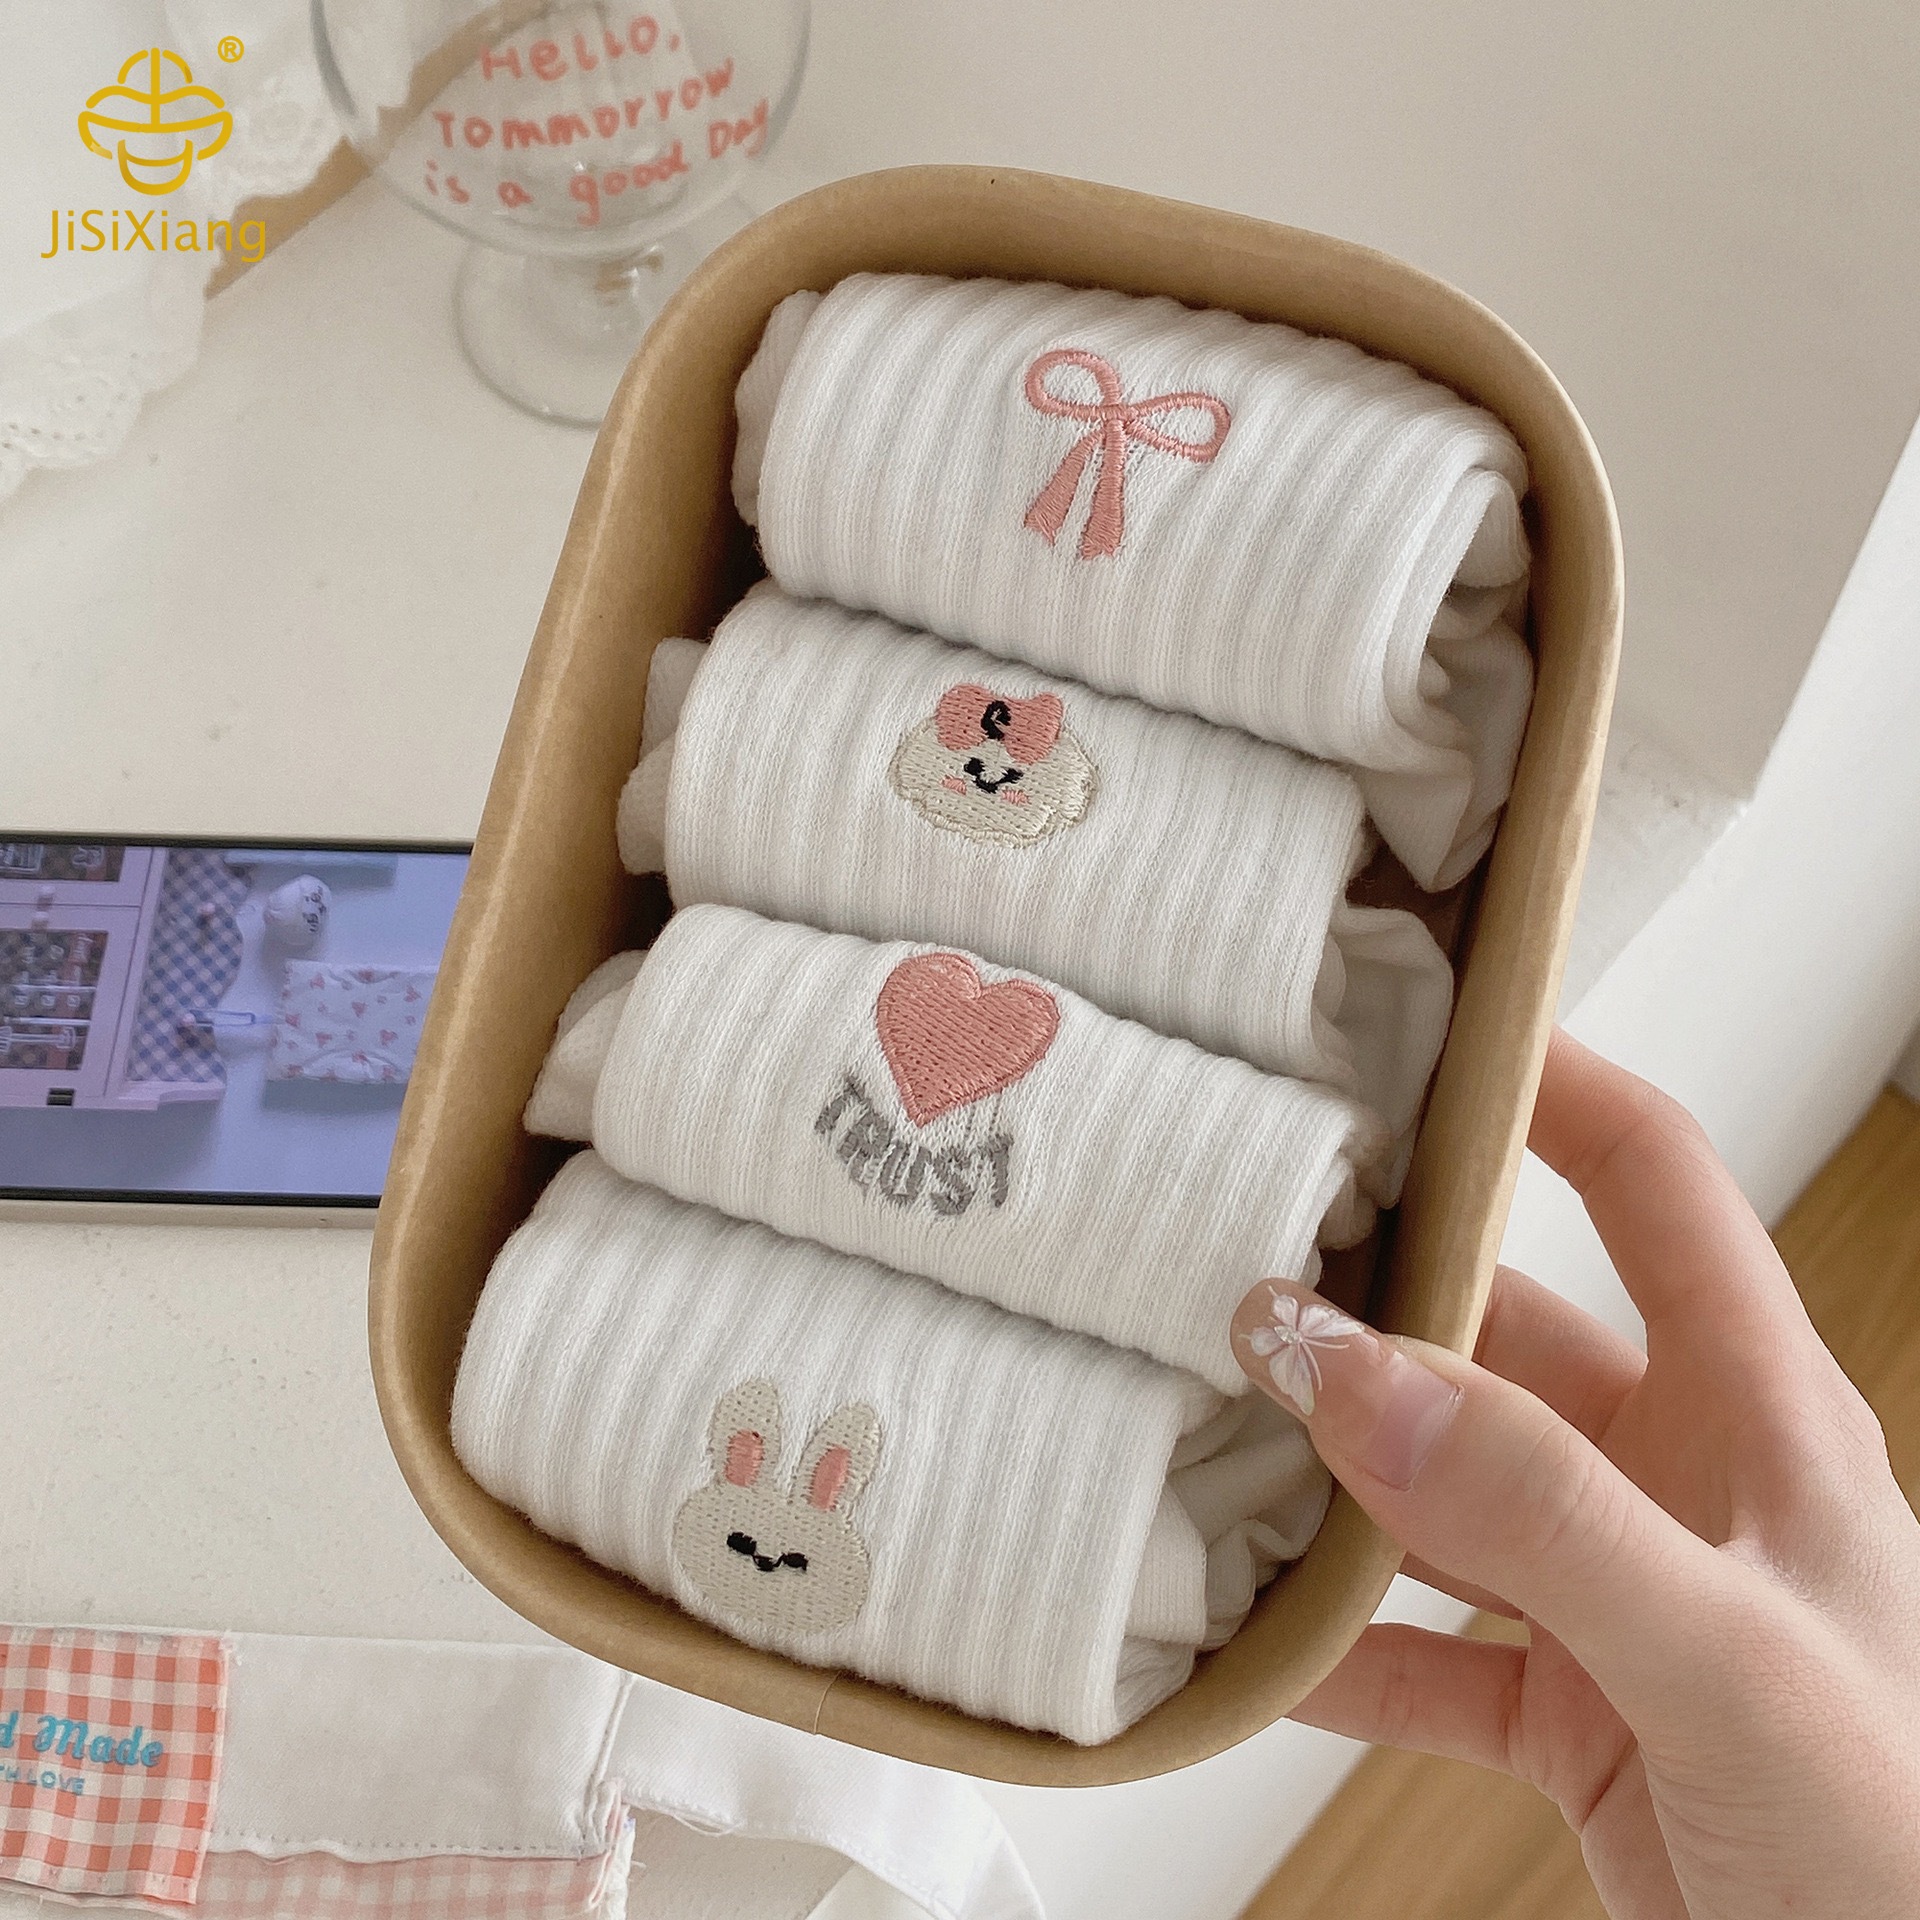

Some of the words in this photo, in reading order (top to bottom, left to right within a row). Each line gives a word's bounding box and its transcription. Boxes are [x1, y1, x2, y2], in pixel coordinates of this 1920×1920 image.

[497, 180, 535, 209] a
[568, 138, 691, 228] good
[813, 1072, 1016, 1218] TRUST
[33, 1713, 164, 1768] Made
[27, 1768, 85, 1796] LOVE
